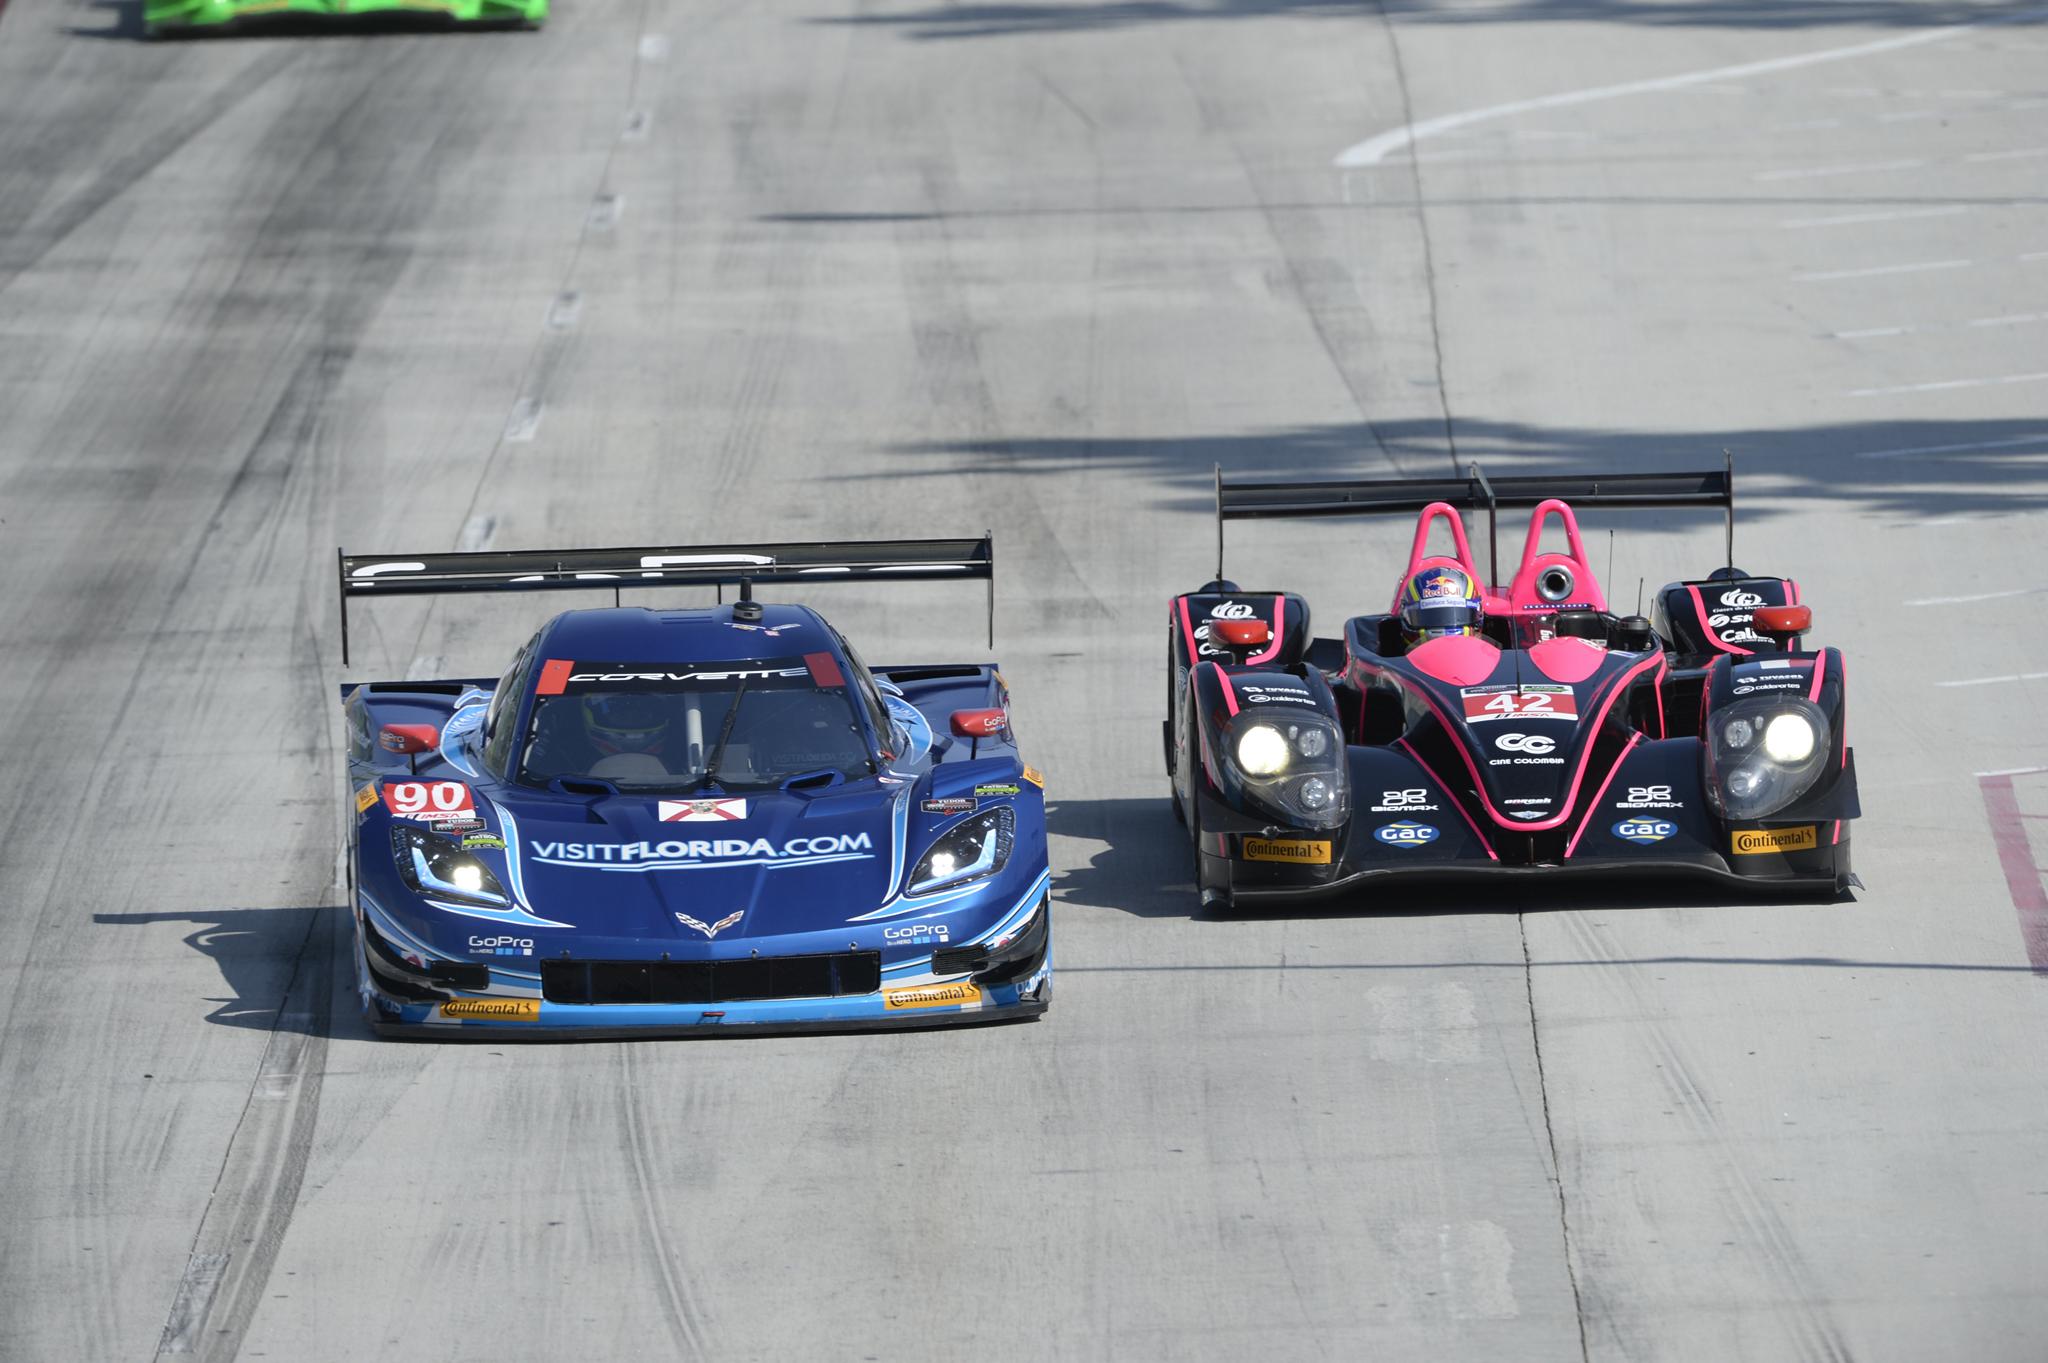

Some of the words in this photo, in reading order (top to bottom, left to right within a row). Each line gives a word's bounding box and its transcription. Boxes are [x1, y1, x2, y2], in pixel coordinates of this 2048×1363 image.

[1423, 587, 1442, 598] Red
[1443, 586, 1461, 597] Bull
[568, 666, 808, 681] CORVETTE
[1484, 693, 1554, 713] 42
[1489, 758, 1511, 766] CINE
[1513, 757, 1565, 765] COLOMBIA
[393, 781, 465, 812] 90
[530, 832, 873, 861] VISITFLORIDA.COM
[1246, 840, 1312, 858] Continental
[1738, 830, 1805, 852] Continental
[884, 925, 948, 939] GoPro
[468, 935, 533, 948] GoPro
[889, 984, 966, 1008] Continental
[445, 999, 520, 1017] Continental
